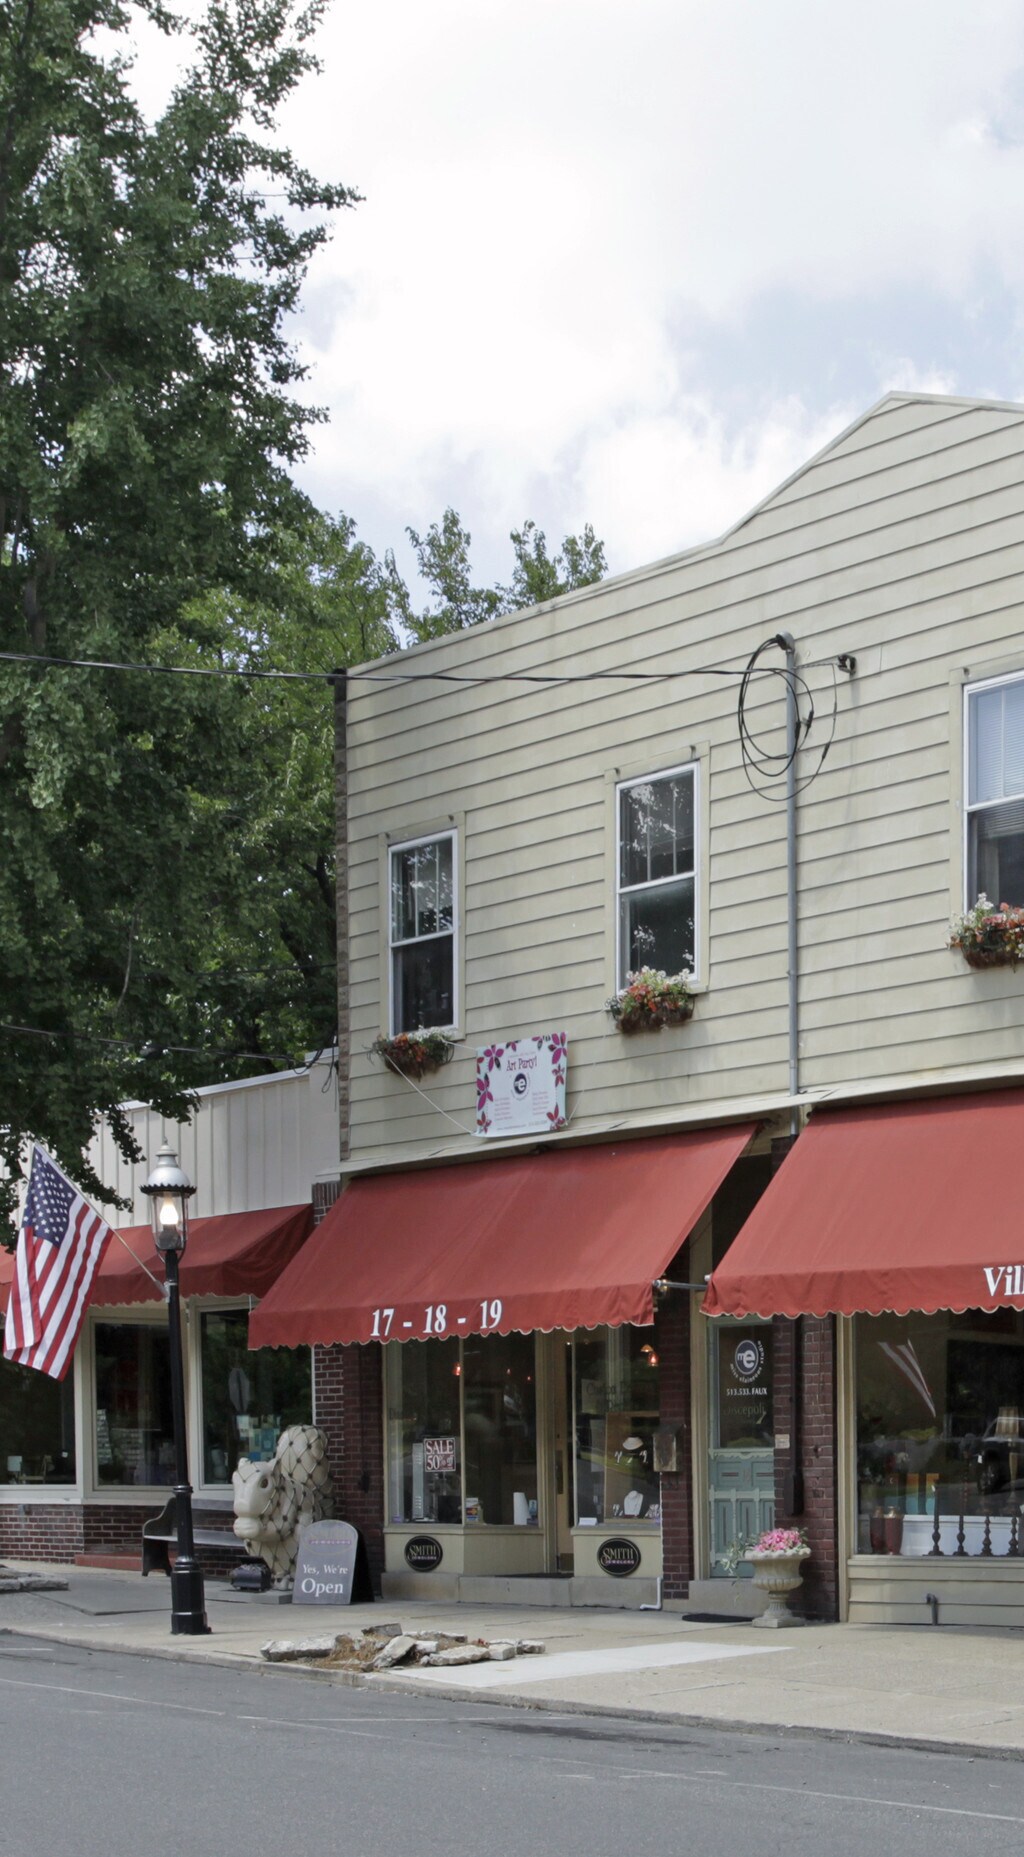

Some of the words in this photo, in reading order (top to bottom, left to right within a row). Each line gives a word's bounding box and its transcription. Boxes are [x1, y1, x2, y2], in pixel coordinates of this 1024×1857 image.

[506, 1059, 517, 1072] Art
[370, 1308, 395, 1336] 17
[422, 1304, 447, 1334] 18
[480, 1299, 502, 1329] 19
[426, 1440, 454, 1455] SALE
[407, 1544, 436, 1560] SMITH
[601, 1547, 634, 1565] SMITH
[323, 1563, 349, 1575] We're
[301, 1577, 344, 1598] Open
